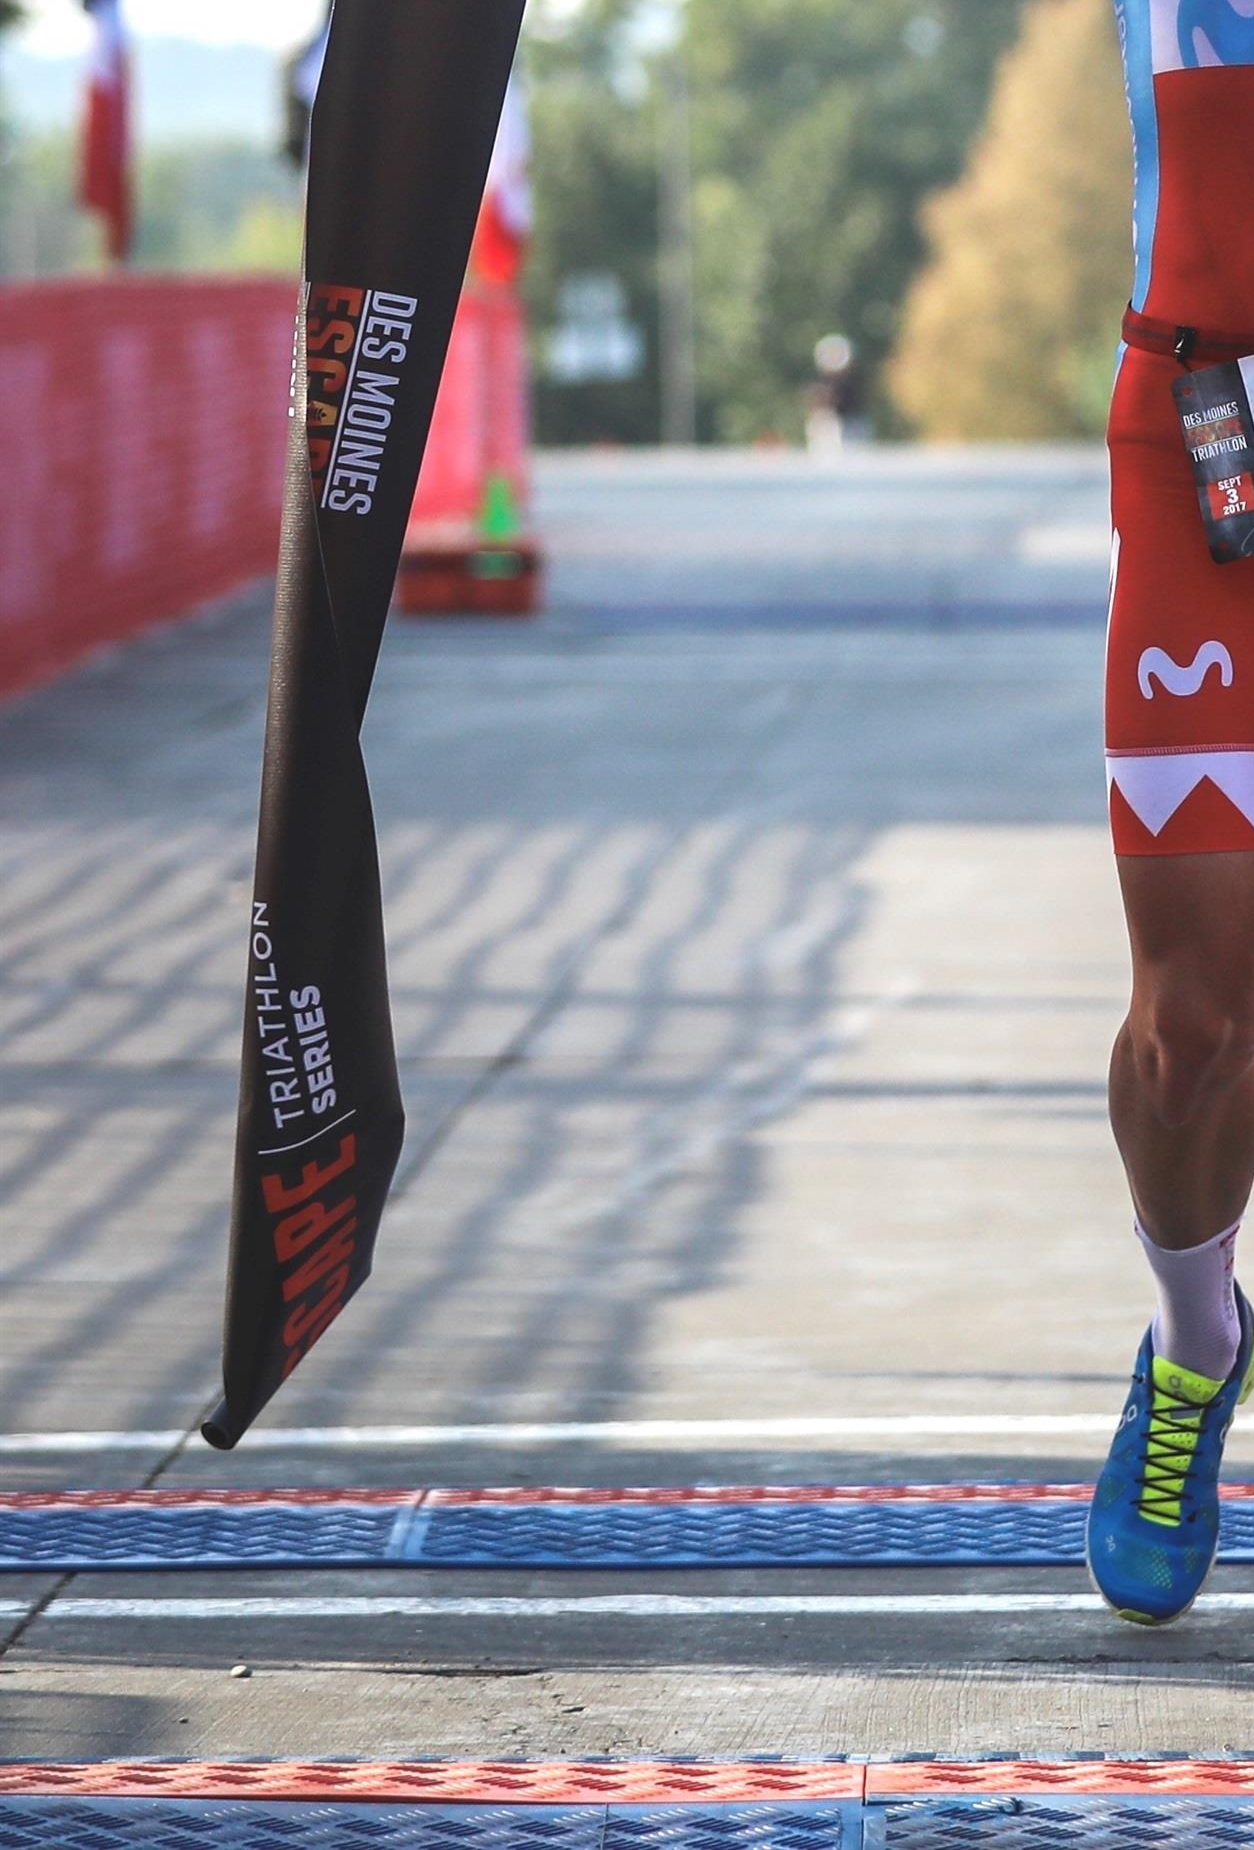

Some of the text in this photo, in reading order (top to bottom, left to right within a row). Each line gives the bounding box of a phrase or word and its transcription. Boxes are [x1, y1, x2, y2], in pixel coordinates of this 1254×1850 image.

[328, 290, 418, 517] DES MOINES
[1182, 401, 1239, 428] DES MOINES
[1192, 436, 1248, 463] TRIATHLON
[1217, 475, 1242, 491] SEPT
[1226, 488, 1239, 504] 3
[1222, 501, 1247, 516] 2017
[251, 901, 305, 1129] TRIATHLON
[289, 984, 339, 1116] SERIES
